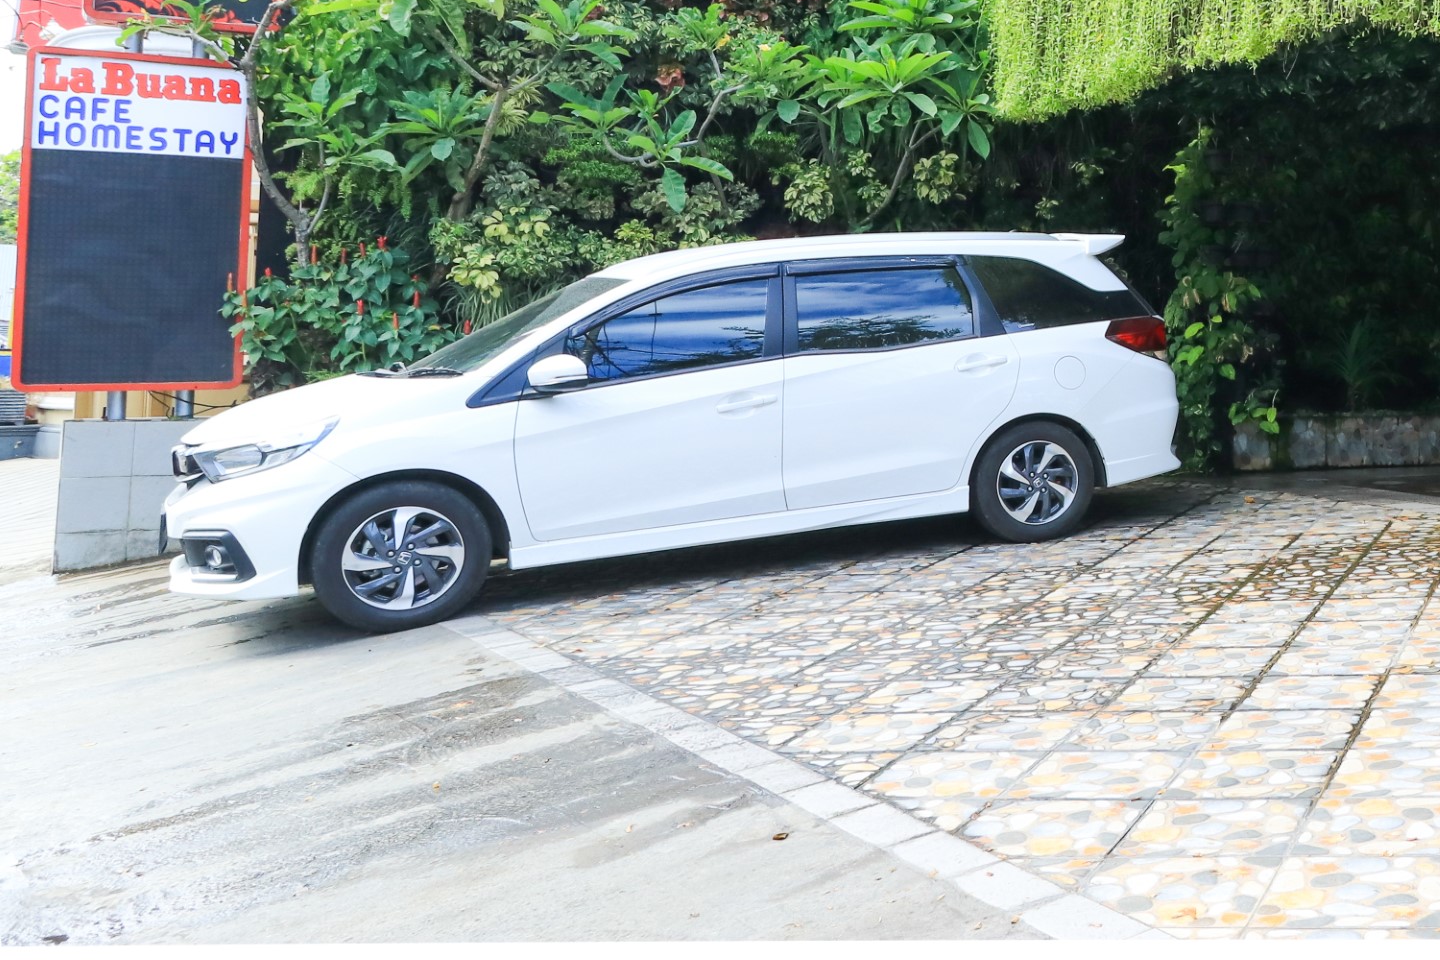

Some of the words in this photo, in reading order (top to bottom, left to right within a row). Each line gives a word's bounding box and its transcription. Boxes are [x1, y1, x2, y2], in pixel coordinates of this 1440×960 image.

[39, 57, 95, 94] La
[101, 62, 242, 105] Buana
[39, 94, 132, 123] CAFE
[37, 120, 238, 155] HOMESTAY
